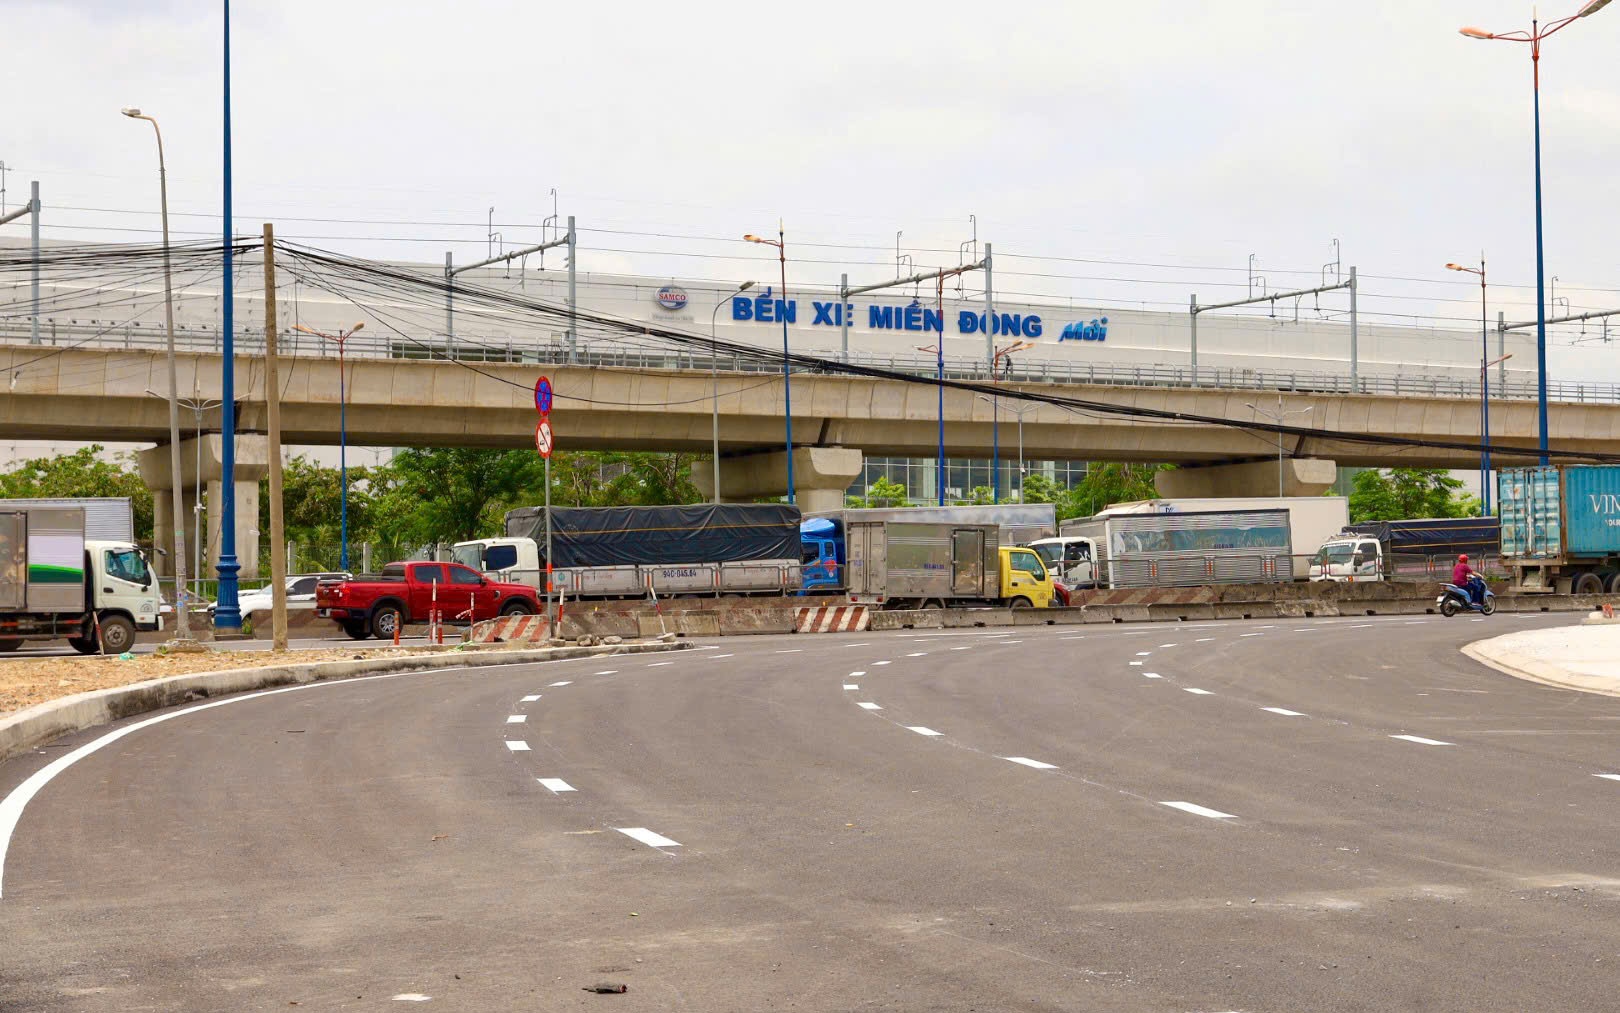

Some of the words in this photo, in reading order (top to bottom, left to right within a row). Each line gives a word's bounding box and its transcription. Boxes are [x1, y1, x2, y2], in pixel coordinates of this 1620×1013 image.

[659, 293, 686, 301] SAMCO
[733, 286, 797, 323] BẾN
[812, 301, 854, 327] XE
[958, 309, 1043, 338] ĐÔNG
